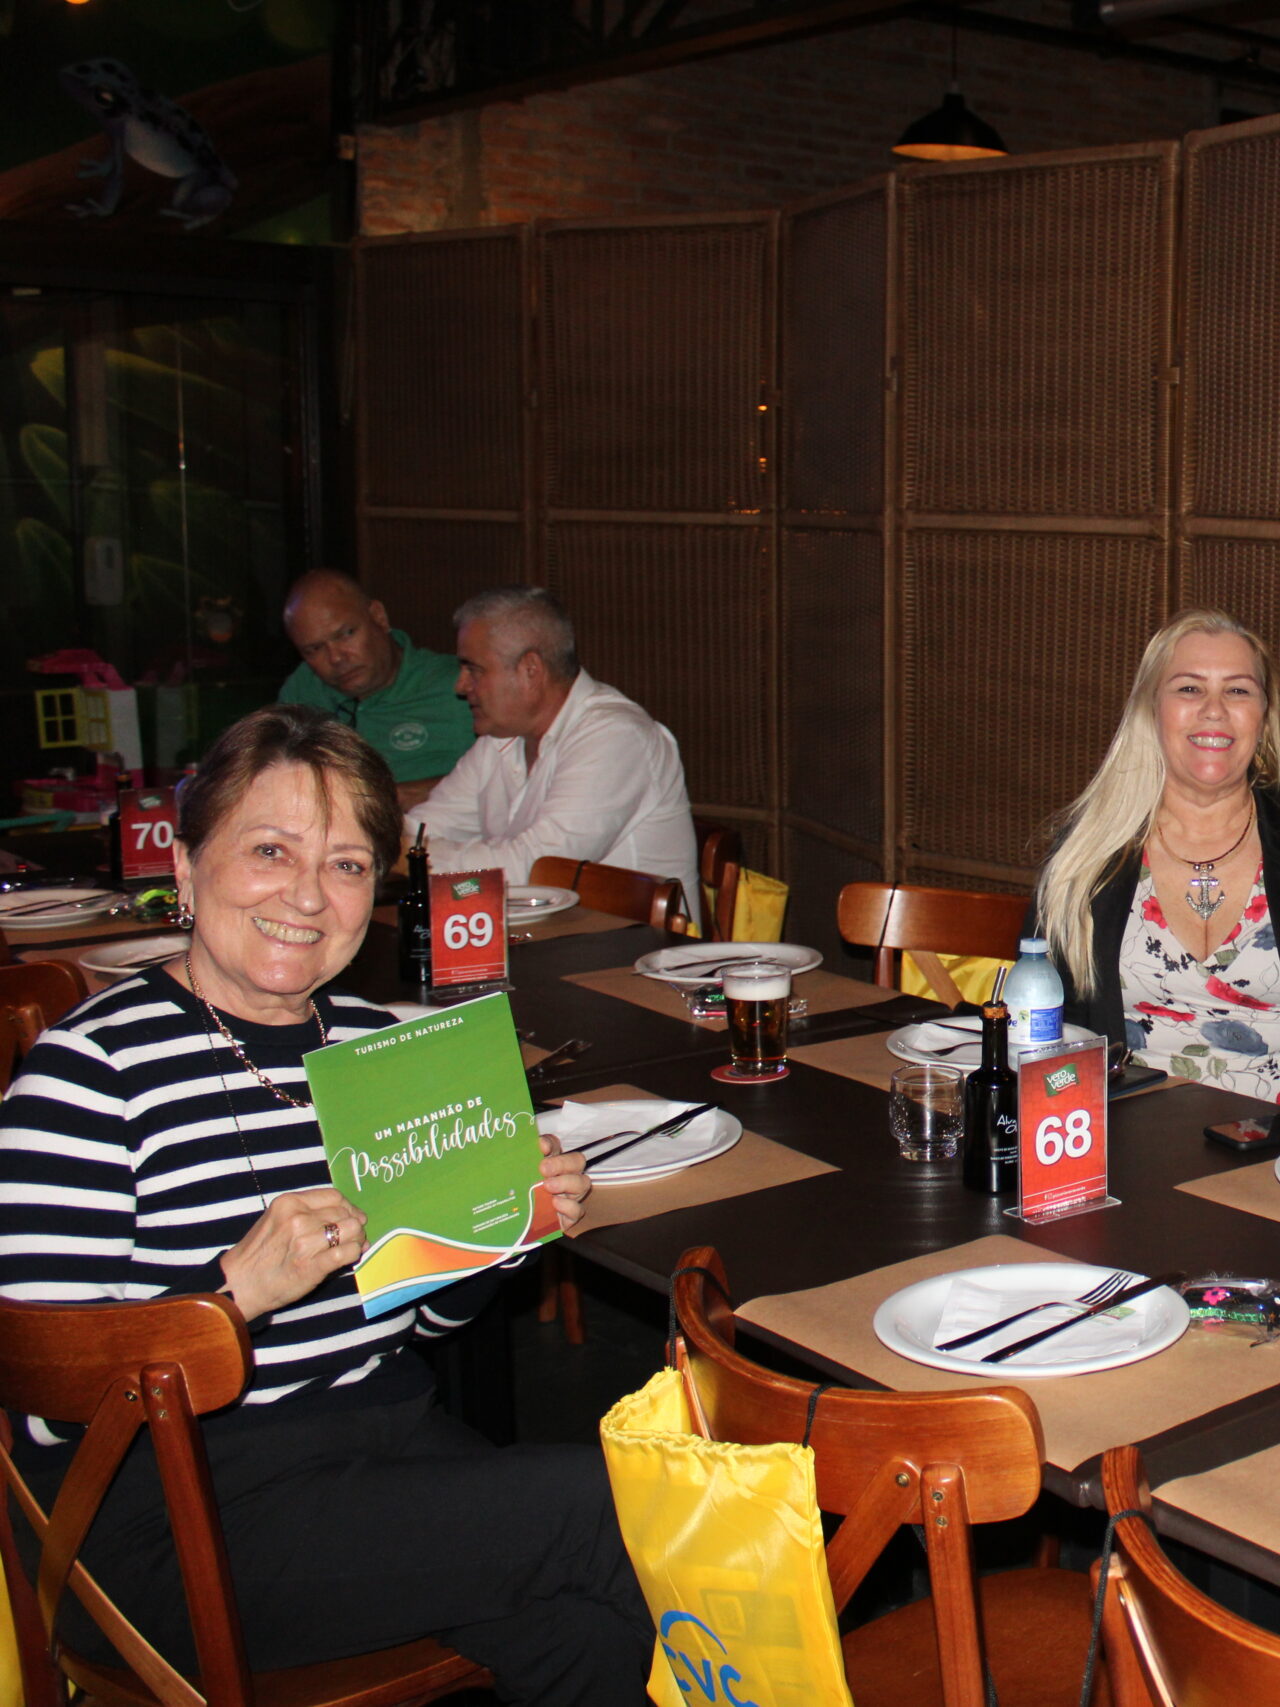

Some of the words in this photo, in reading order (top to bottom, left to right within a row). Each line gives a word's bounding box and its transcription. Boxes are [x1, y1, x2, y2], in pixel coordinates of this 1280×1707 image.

[131, 821, 174, 849] 70
[444, 912, 494, 950] 69
[354, 1036, 397, 1056] TURISMO
[399, 1030, 413, 1043] DE
[415, 1016, 464, 1038] NATUREZA
[1046, 1070, 1067, 1084] vero
[1051, 1072, 1076, 1090] verde
[375, 1128, 393, 1141] UM
[396, 1104, 463, 1134] MARANHÃO
[467, 1096, 483, 1110] DE
[1036, 1109, 1092, 1165] 68
[329, 1108, 535, 1192] Possibilidades
